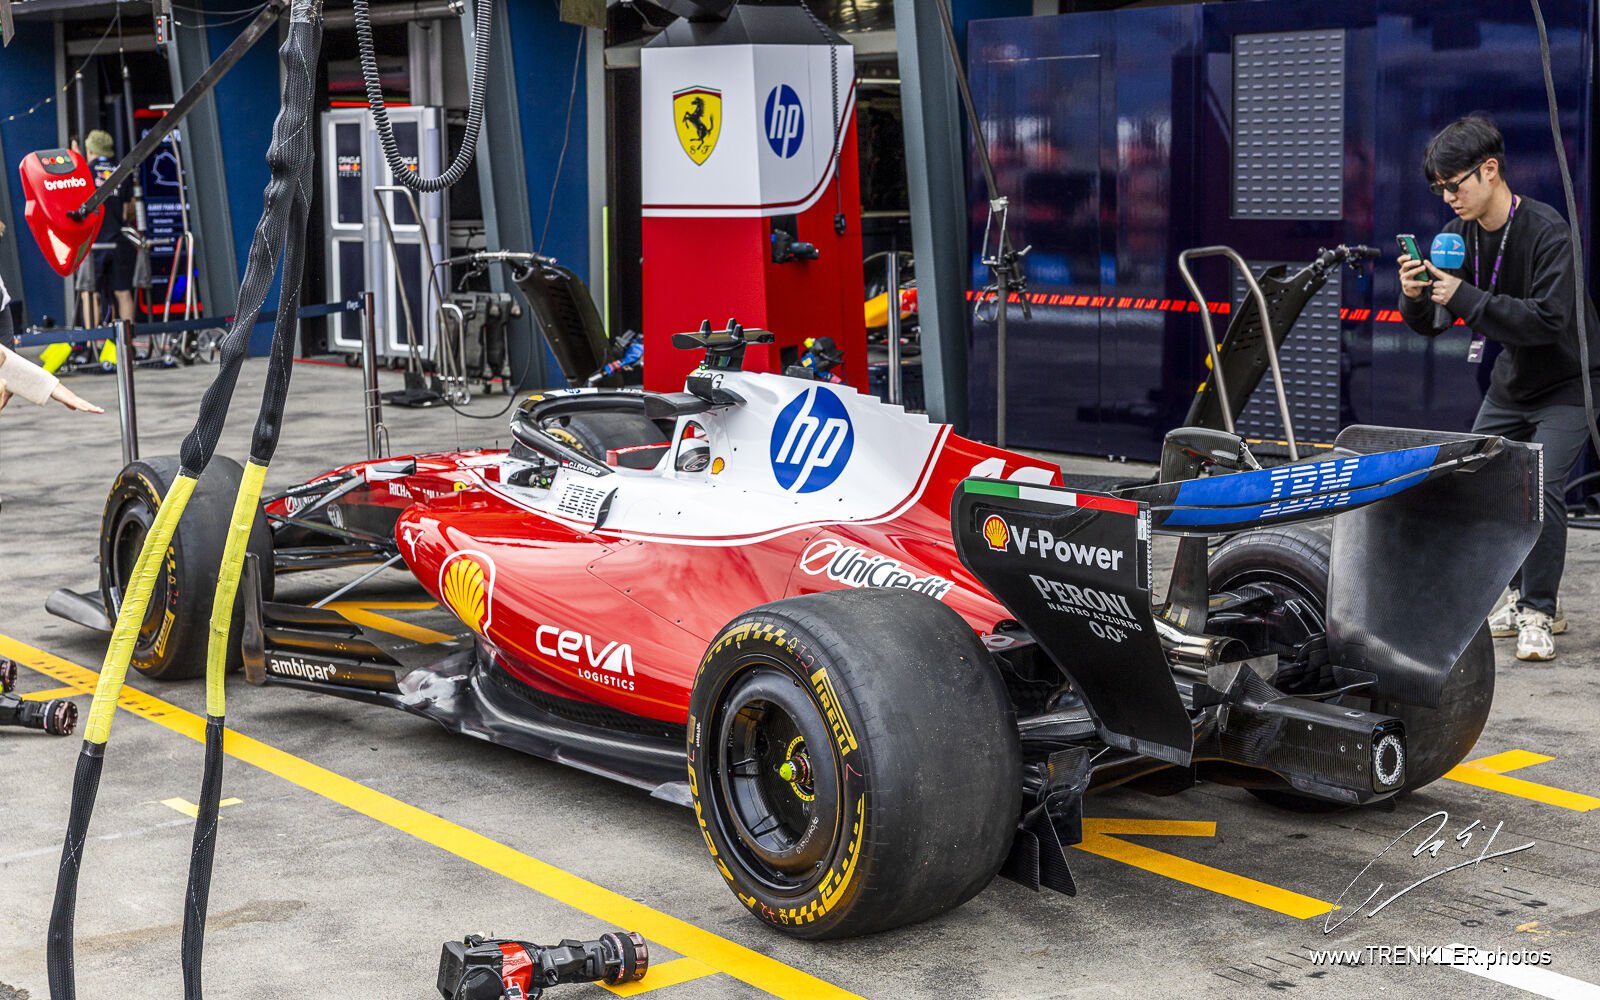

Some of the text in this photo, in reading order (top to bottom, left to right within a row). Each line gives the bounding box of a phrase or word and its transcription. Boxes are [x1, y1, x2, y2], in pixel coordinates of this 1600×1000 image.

[769, 84, 801, 158] hp
[44, 176, 87, 191] brembo
[773, 385, 850, 493] hp
[1259, 458, 1361, 518] IBM
[1010, 525, 1124, 571] V-Power
[829, 548, 951, 598] UniCredit
[1029, 574, 1137, 621] PERONI
[1047, 602, 1143, 632] NASTRO AZZURRO
[271, 658, 329, 680] ambipar
[578, 668, 636, 691] LOGISTICS
[810, 667, 858, 757] PIRELLI
